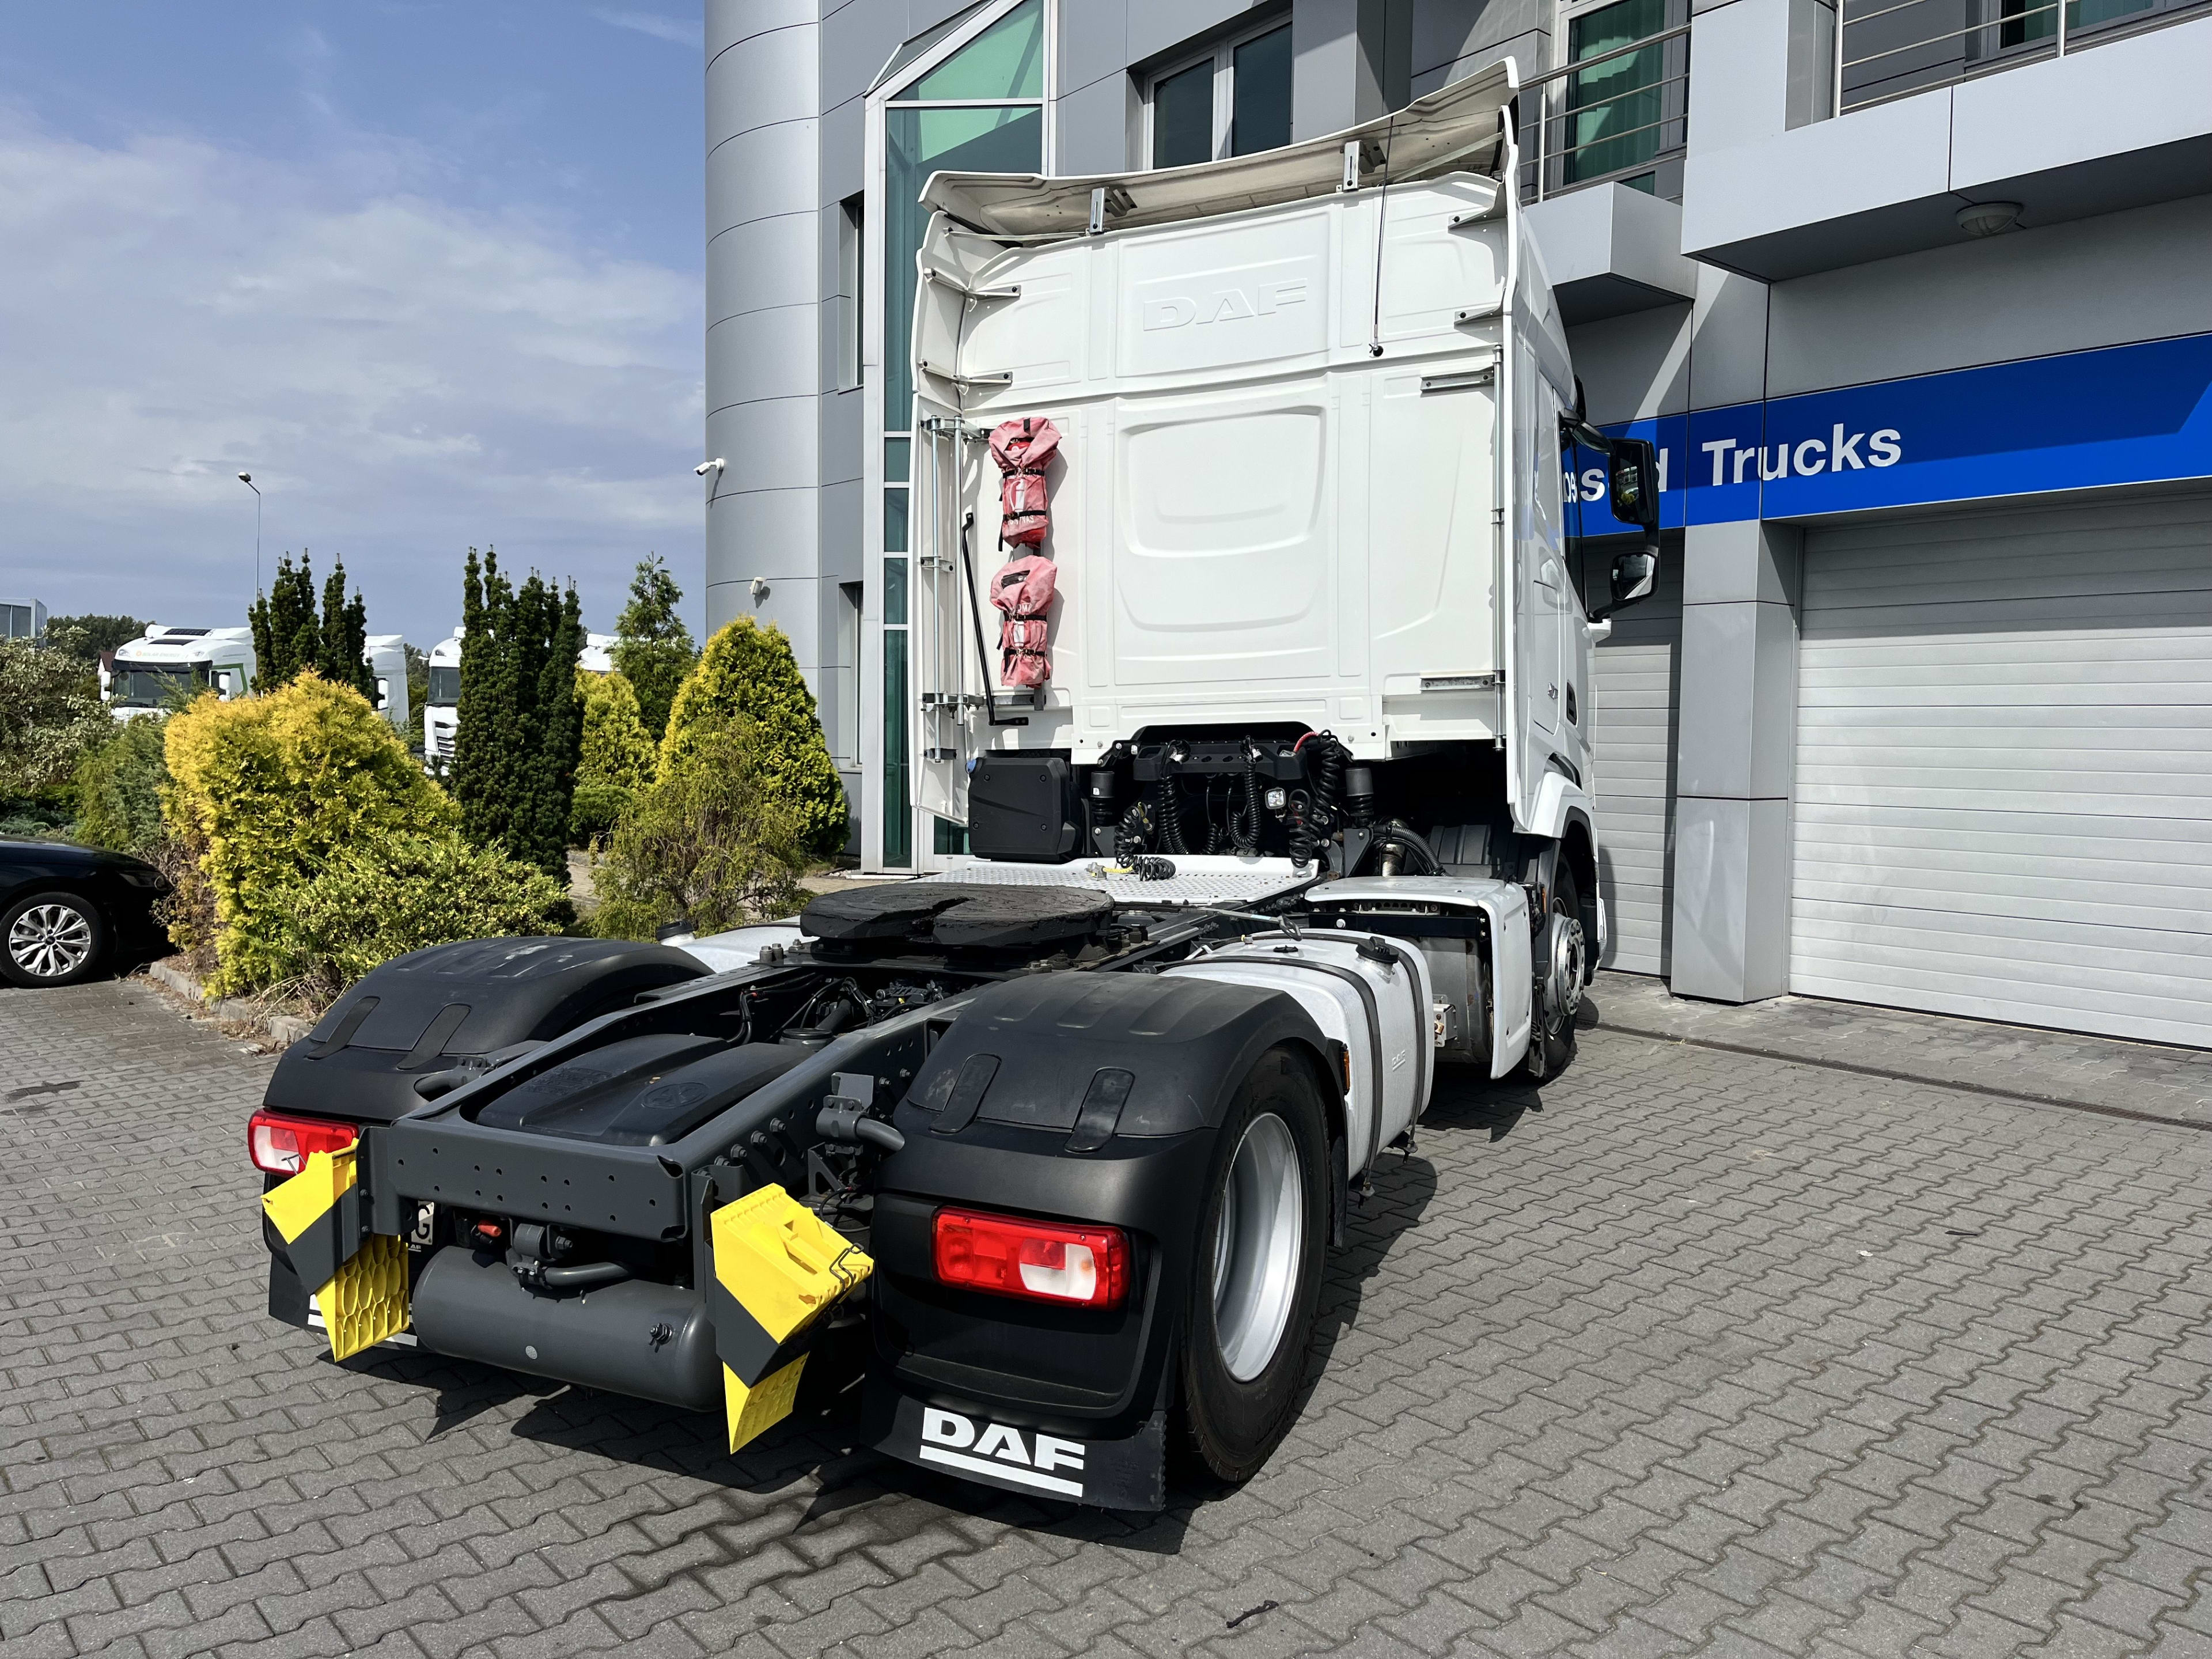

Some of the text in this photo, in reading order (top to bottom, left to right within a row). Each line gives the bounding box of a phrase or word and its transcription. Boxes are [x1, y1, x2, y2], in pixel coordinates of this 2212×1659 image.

[1143, 278, 1308, 331] DAF
[1702, 423, 1901, 486] Trucks
[922, 1407, 1085, 1471] DAF
